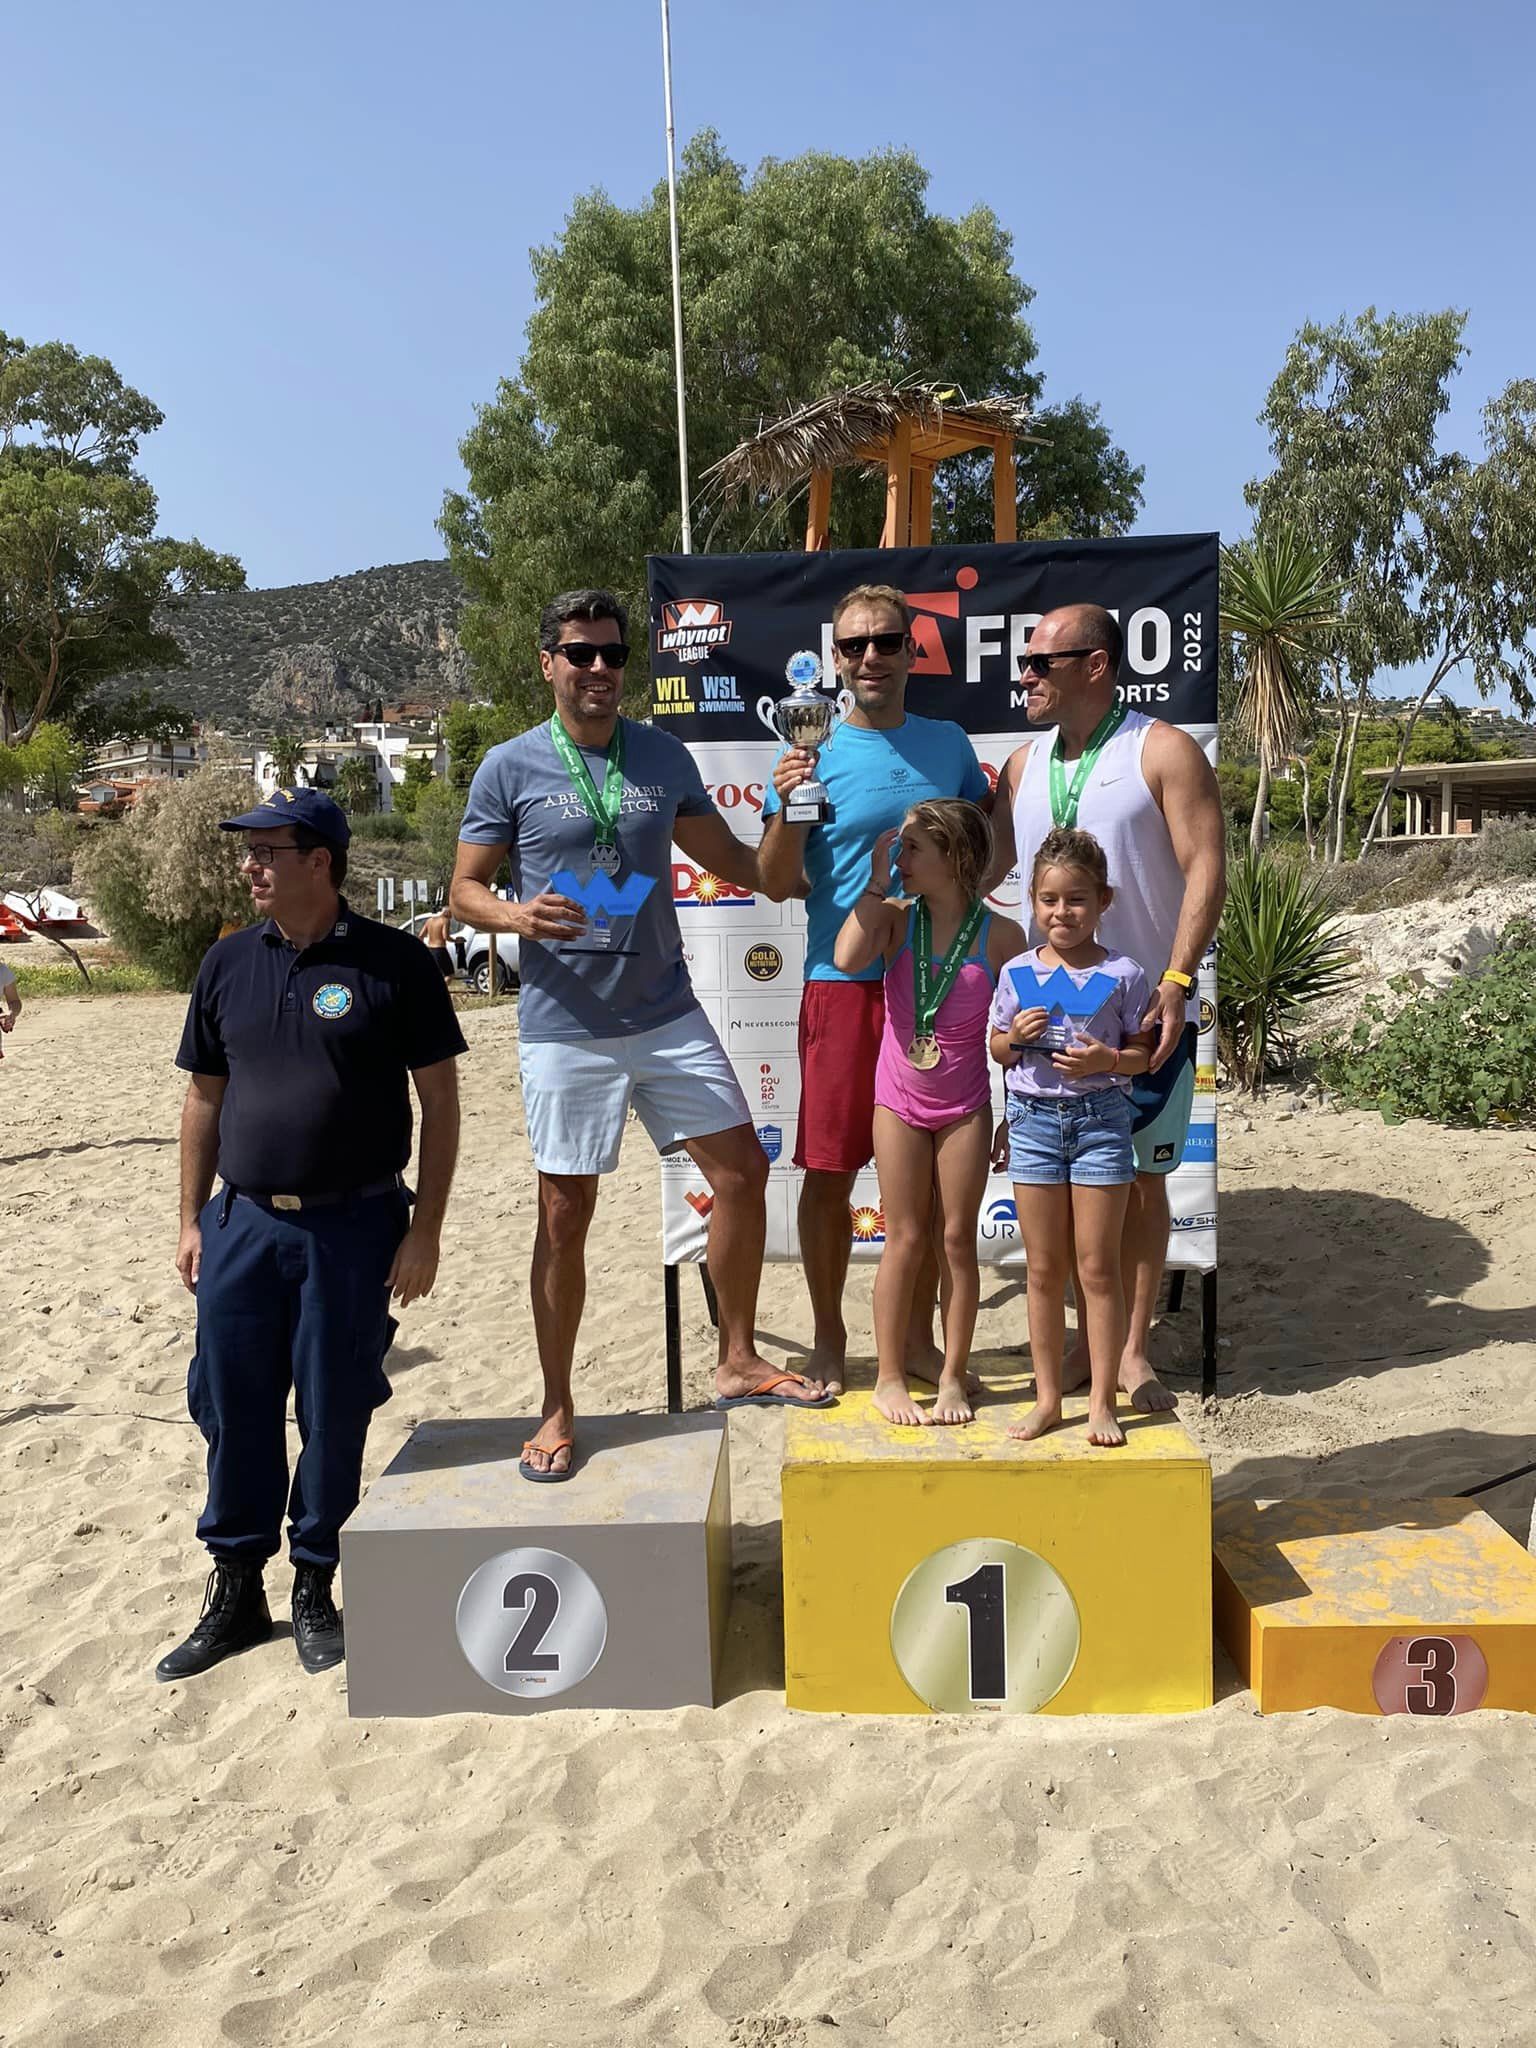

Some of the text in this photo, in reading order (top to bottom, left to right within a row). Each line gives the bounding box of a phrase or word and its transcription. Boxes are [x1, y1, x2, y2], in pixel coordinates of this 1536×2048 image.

[662, 626, 727, 649] whynot
[1183, 611, 1202, 672] 2022
[679, 646, 710, 662] LEAGUE
[656, 677, 690, 701] WTL
[702, 676, 741, 699] WSL
[653, 702, 695, 715] TRIATHLON
[699, 701, 745, 713] SWIMMING
[751, 951, 776, 960] GOLD
[761, 1077, 780, 1085] FOU
[761, 1093, 775, 1101] RO
[502, 1571, 561, 1673] 2
[945, 1563, 1006, 1701] 1
[1406, 1636, 1457, 1716] 3
